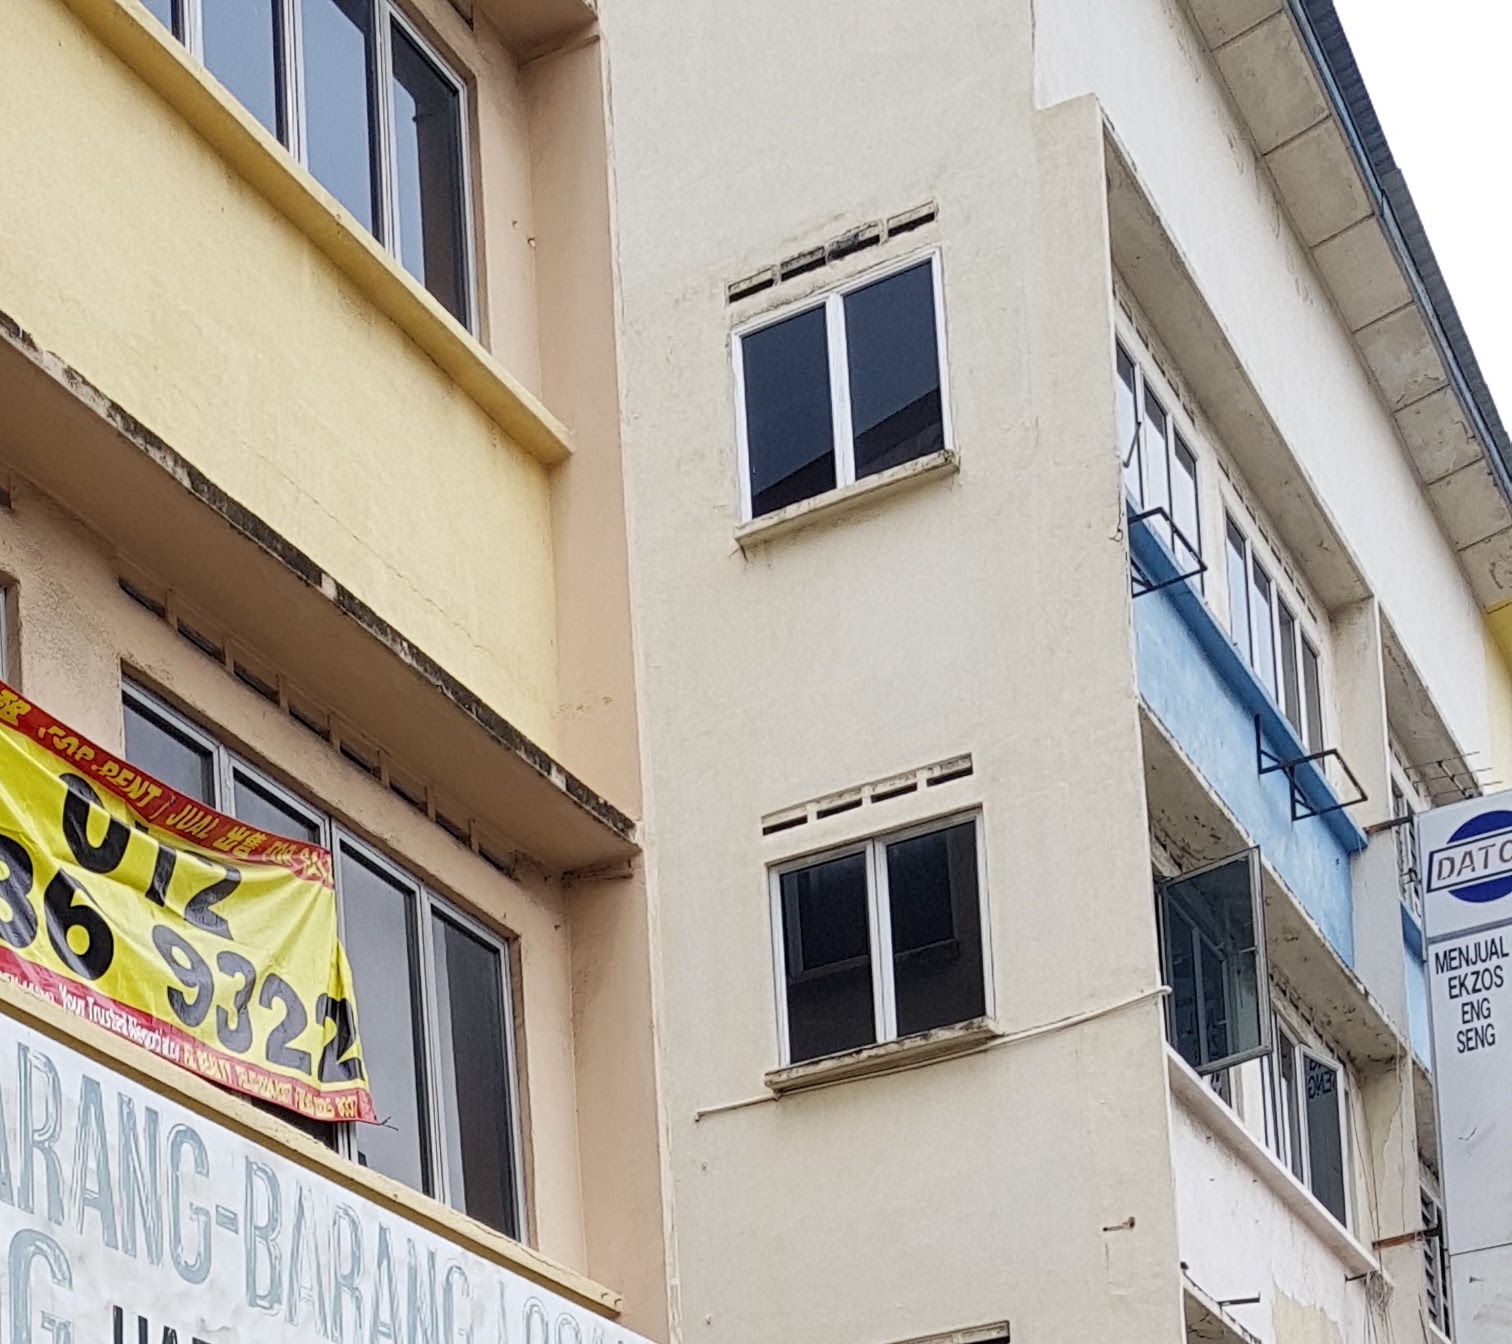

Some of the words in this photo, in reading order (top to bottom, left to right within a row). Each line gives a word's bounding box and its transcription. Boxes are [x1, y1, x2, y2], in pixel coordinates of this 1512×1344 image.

[166, 804, 220, 840] JUAL
[1434, 936, 1510, 976] MENJUAL
[1447, 965, 1504, 1000] EKZOS
[151, 923, 365, 1084] 9322
[1461, 997, 1492, 1025] ENG
[1456, 1022, 1496, 1054] SENG
